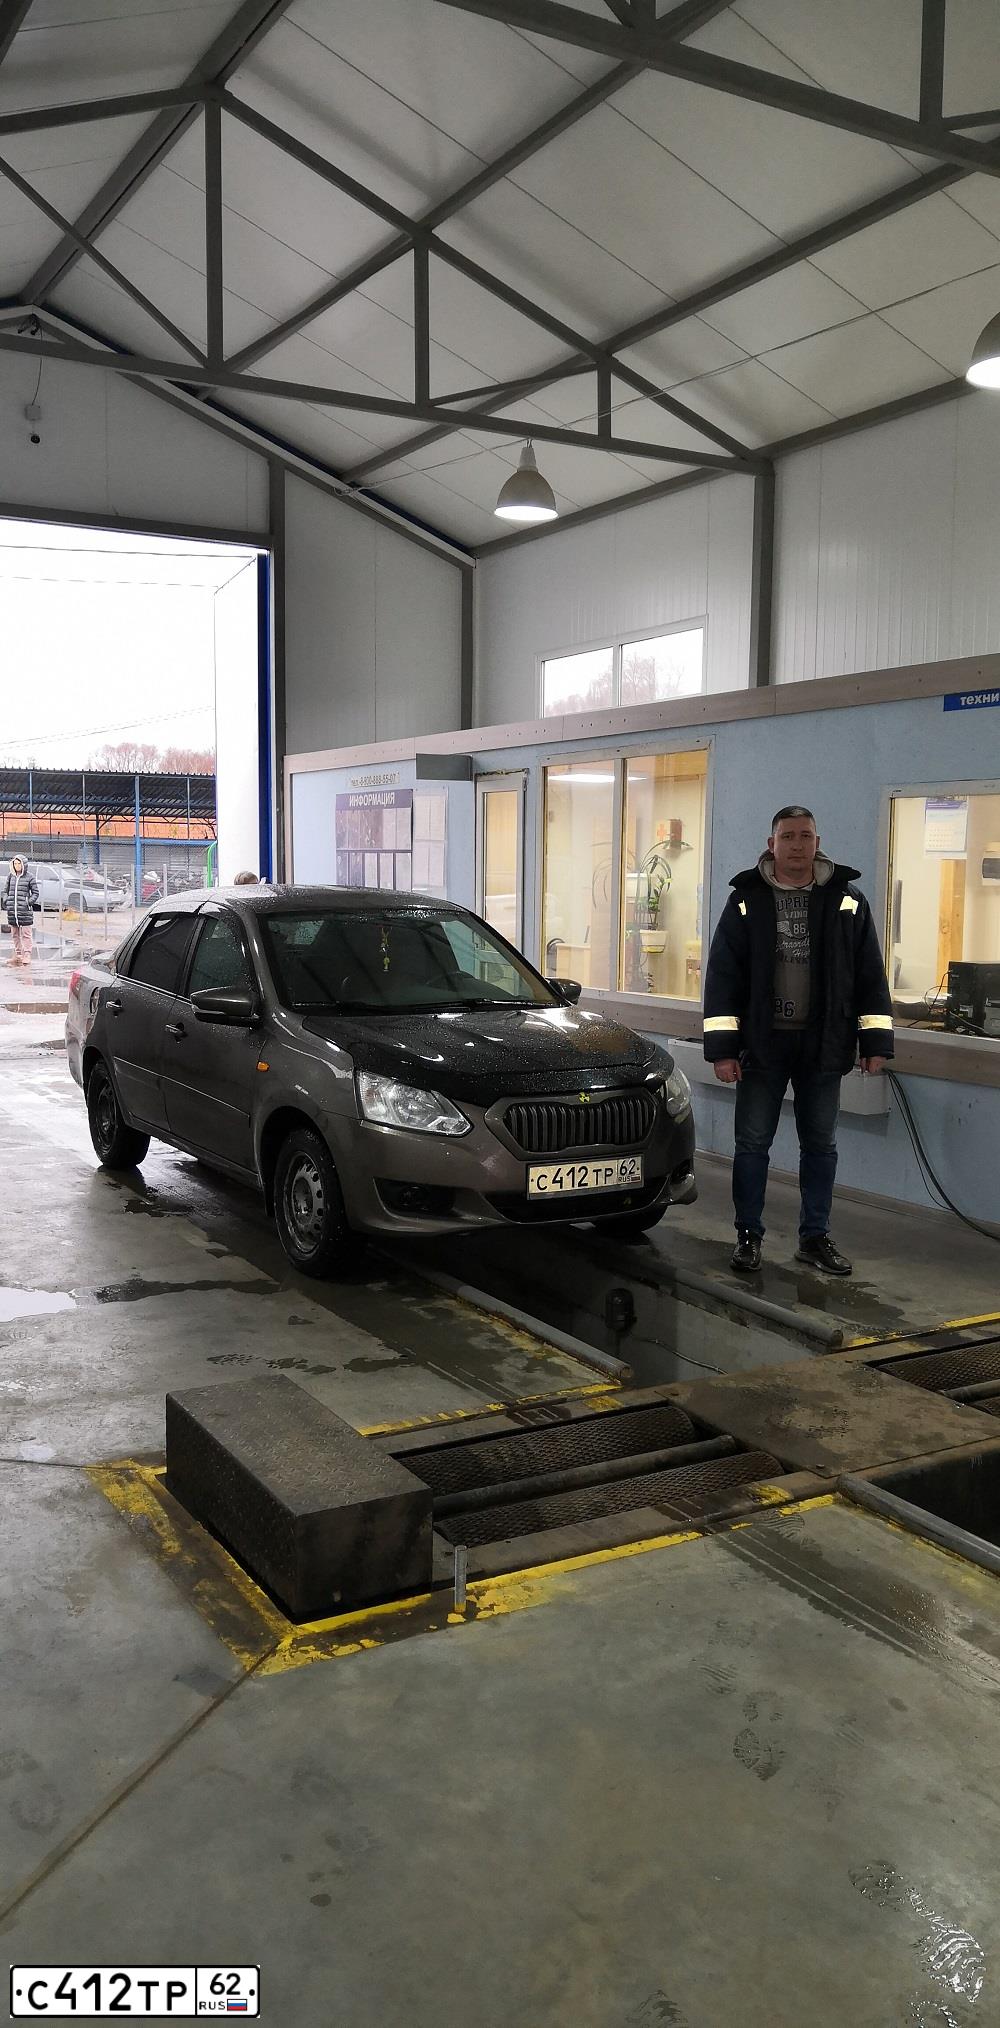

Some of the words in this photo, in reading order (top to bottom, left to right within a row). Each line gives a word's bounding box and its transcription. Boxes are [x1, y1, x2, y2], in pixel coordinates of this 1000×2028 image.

[960, 692, 1000, 706] техни
[349, 792, 395, 807] ИНФОРМАЦИЯ
[793, 923, 806, 934] 86
[619, 1159, 636, 1176] 62
